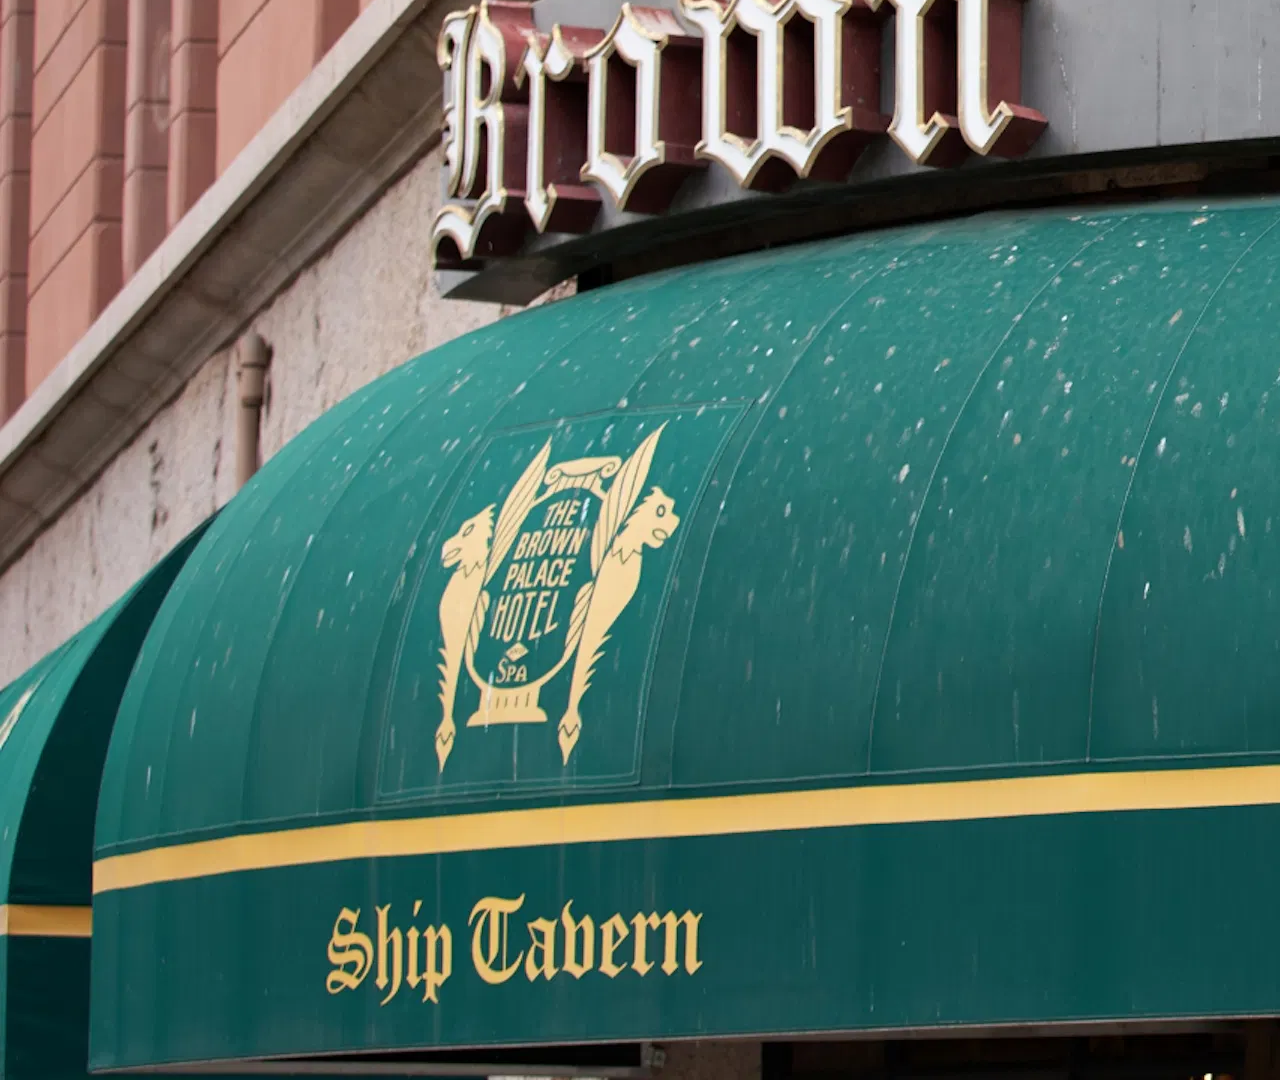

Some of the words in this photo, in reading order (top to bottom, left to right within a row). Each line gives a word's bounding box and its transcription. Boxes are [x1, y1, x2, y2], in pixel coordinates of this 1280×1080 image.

[546, 500, 580, 526] THE
[516, 529, 587, 559] BROWN
[503, 559, 576, 591] PALACE
[490, 591, 559, 642] HOTEL
[325, 899, 453, 1007] Ship
[467, 892, 704, 985] Tavern
